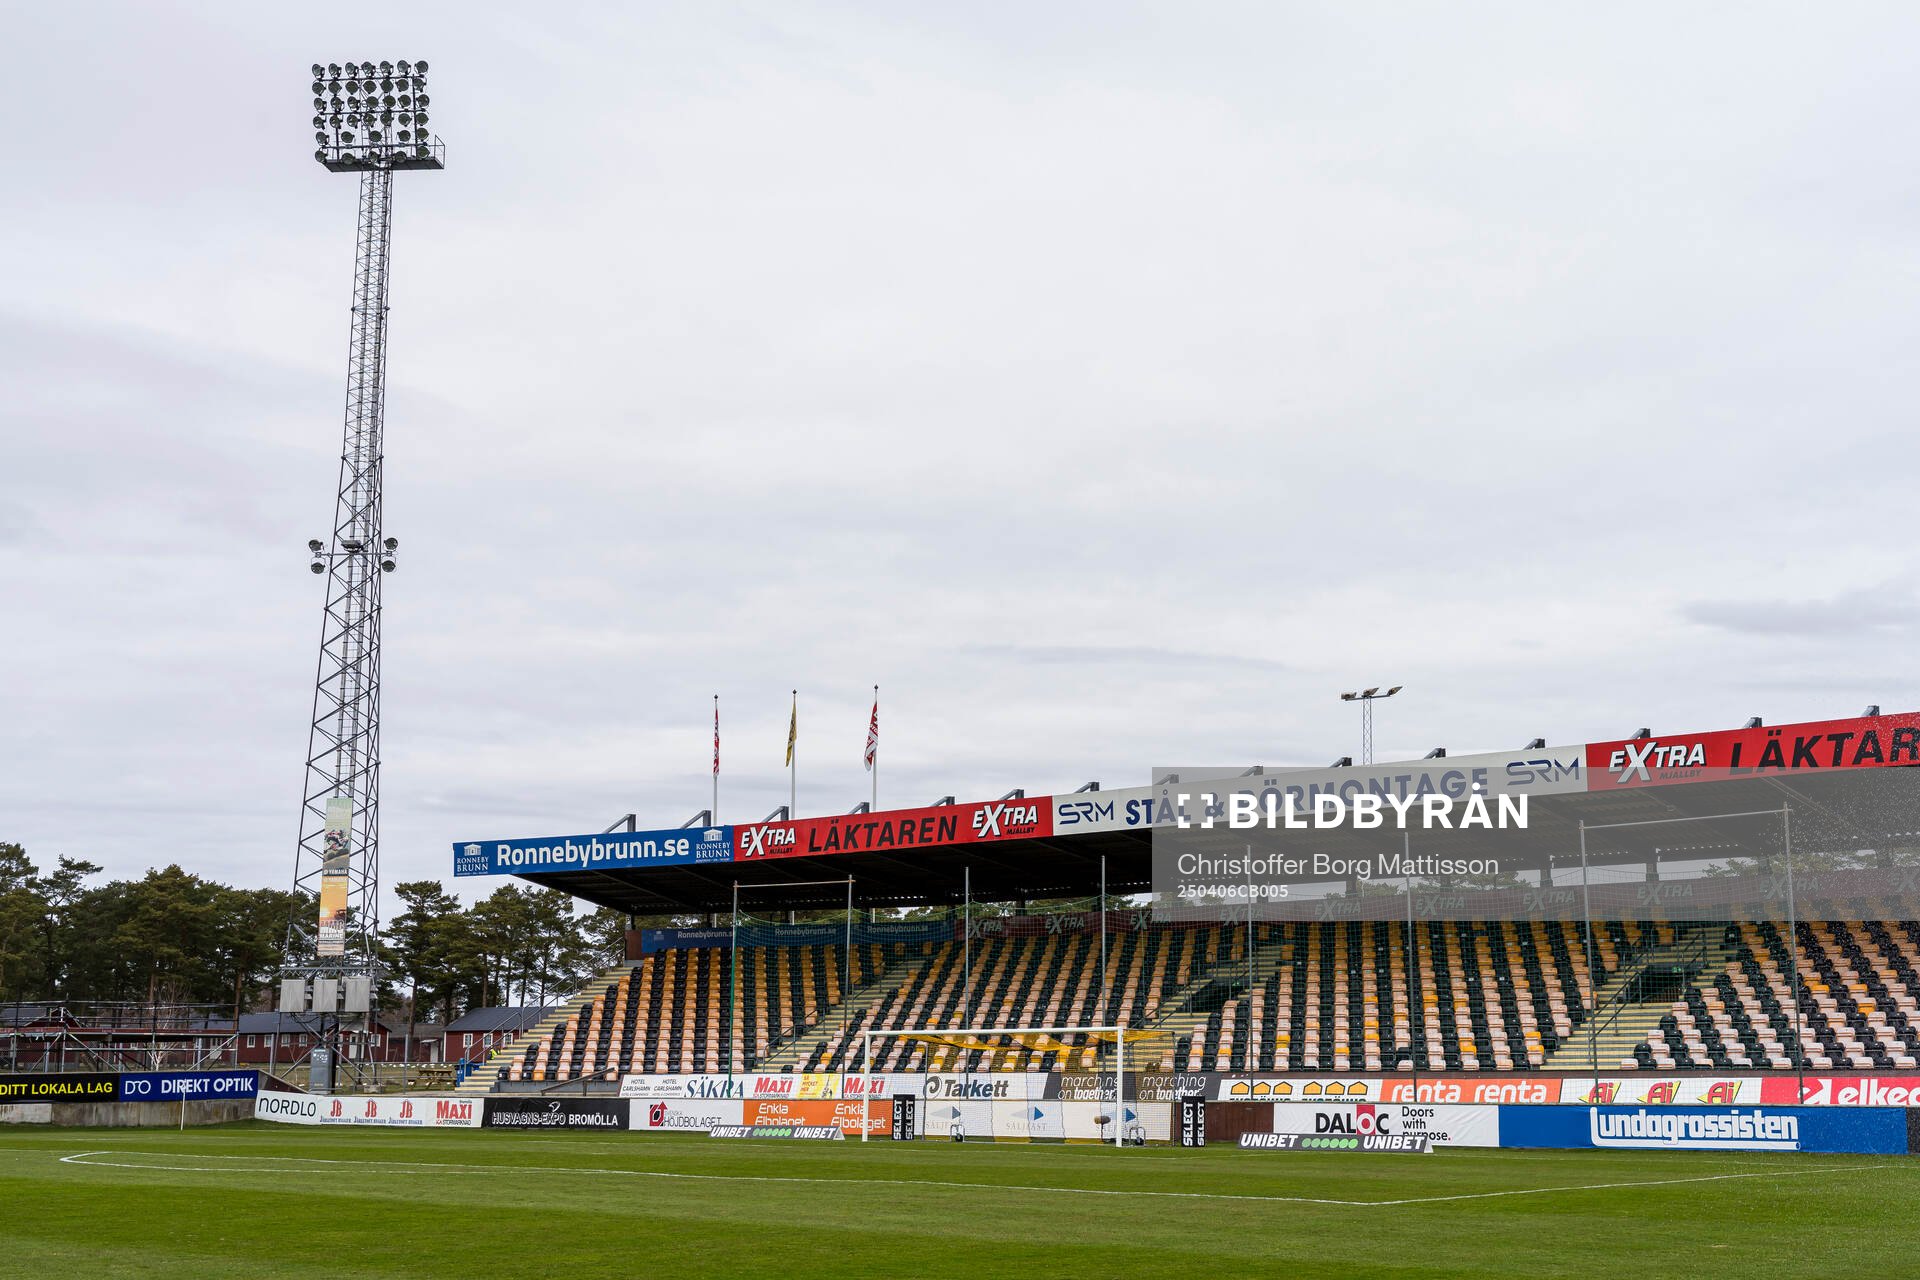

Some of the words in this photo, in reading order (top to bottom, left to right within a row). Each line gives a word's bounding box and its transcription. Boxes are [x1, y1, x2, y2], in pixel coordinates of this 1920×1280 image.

[1506, 757, 1580, 786] SRM
[1609, 742, 1707, 784] EXTRA
[972, 804, 1038, 838] EXTRA
[1059, 801, 1114, 826] SRM
[741, 826, 796, 857] EXTRA
[807, 815, 958, 853] LÄKTAREN
[497, 838, 690, 868] Ronnebybrunn.se
[695, 842, 731, 850] RONNEBY
[696, 849, 730, 859] BRUNN
[456, 856, 489, 864] RONNEBY
[456, 863, 489, 873] BRUNN
[677, 930, 733, 940] Ronnebybrunn.s
[0, 1084, 28, 1095] DITT
[31, 1083, 84, 1095] LOKALA
[86, 1082, 113, 1094] LAG
[161, 1079, 210, 1094] DIREKT
[214, 1077, 254, 1093] OPTIK
[684, 1076, 744, 1098] SÄKRA
[754, 1077, 793, 1093] MAXI
[945, 1079, 1009, 1098] Tarkett
[1061, 1074, 1117, 1087] marchng
[1142, 1073, 1206, 1091] marching
[1058, 1089, 1072, 1100] on
[1140, 1089, 1154, 1100] on
[1392, 1080, 1462, 1103] renta
[1474, 1080, 1547, 1103] renta
[436, 1100, 472, 1119] MAXI
[758, 1103, 789, 1115] Enkla
[1402, 1105, 1434, 1117] Doors
[492, 1112, 566, 1126] HUSVAGNS-EXPO
[568, 1112, 619, 1126] BROMÖLLA
[893, 1099, 902, 1140] SELECT
[905, 1099, 914, 1140] SELECT
[1183, 1102, 1194, 1147] SELECT
[1197, 1102, 1205, 1146] SELECT
[1315, 1112, 1390, 1135] DALOC
[1402, 1117, 1426, 1129] with
[710, 1126, 752, 1138] UNIBET
[794, 1127, 836, 1139] UNIBET
[1590, 1107, 1799, 1150] Lundagrossisten
[1240, 1134, 1299, 1148] UNIBET
[1363, 1136, 1428, 1150] UNIBET
